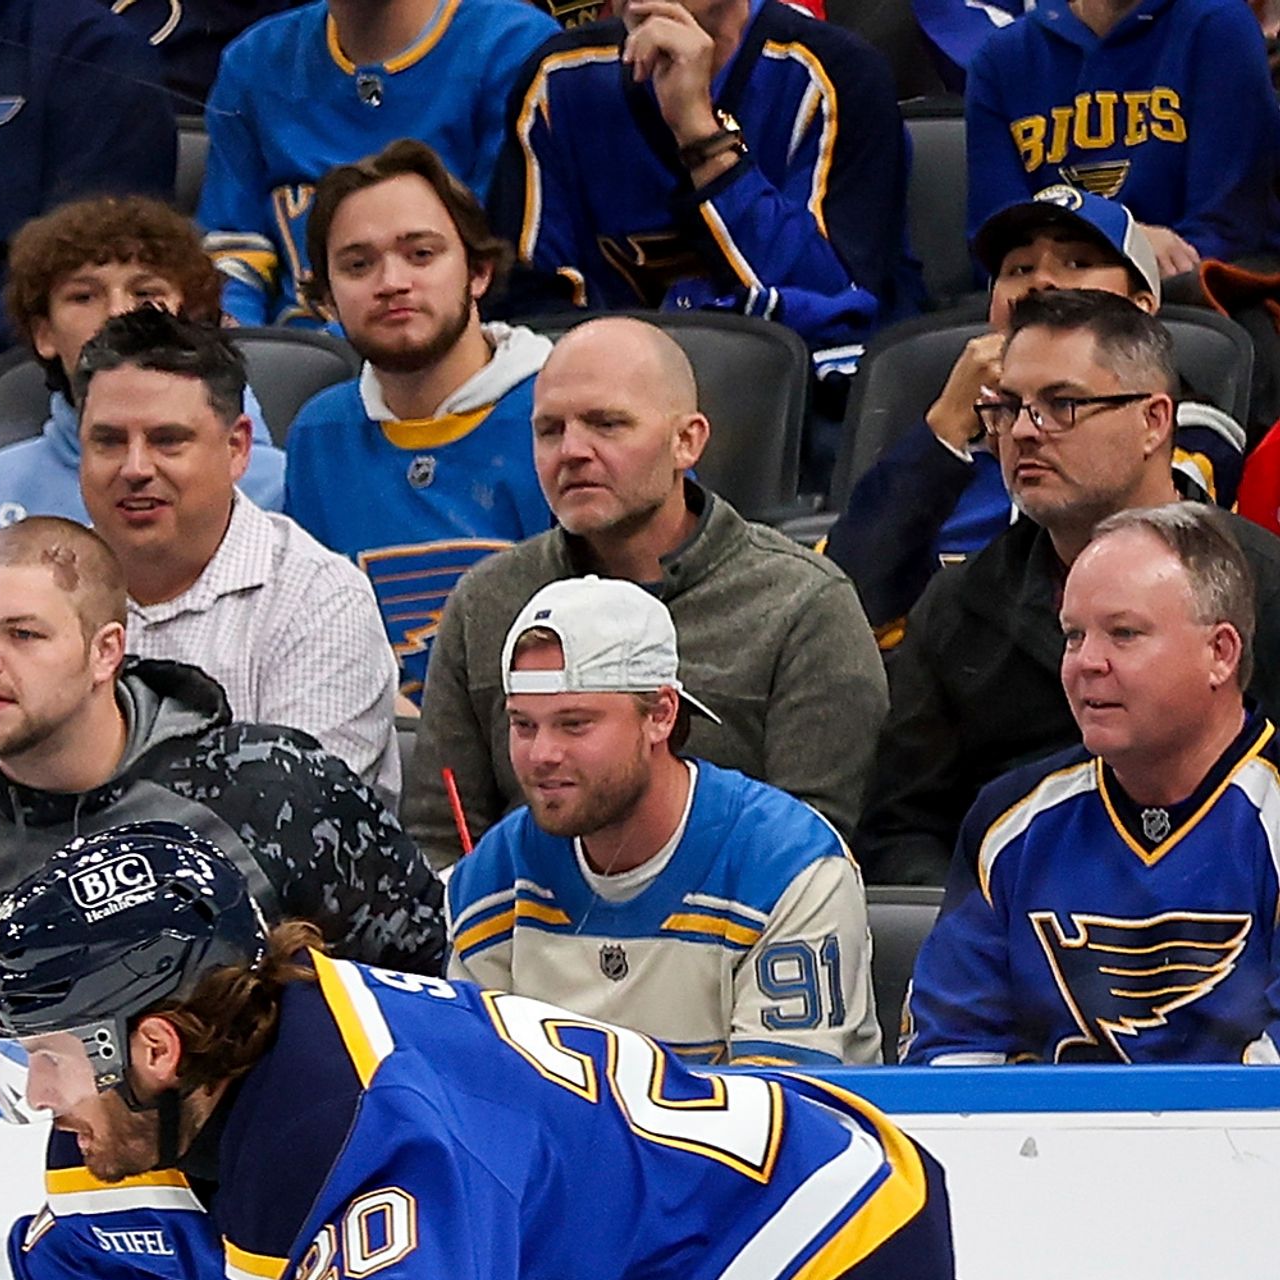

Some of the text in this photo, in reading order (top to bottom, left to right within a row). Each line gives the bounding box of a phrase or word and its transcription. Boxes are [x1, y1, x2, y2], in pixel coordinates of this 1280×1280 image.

[74, 858, 146, 903] BJC
[755, 933, 846, 1031] 91
[90, 1224, 175, 1256] STIFEL
